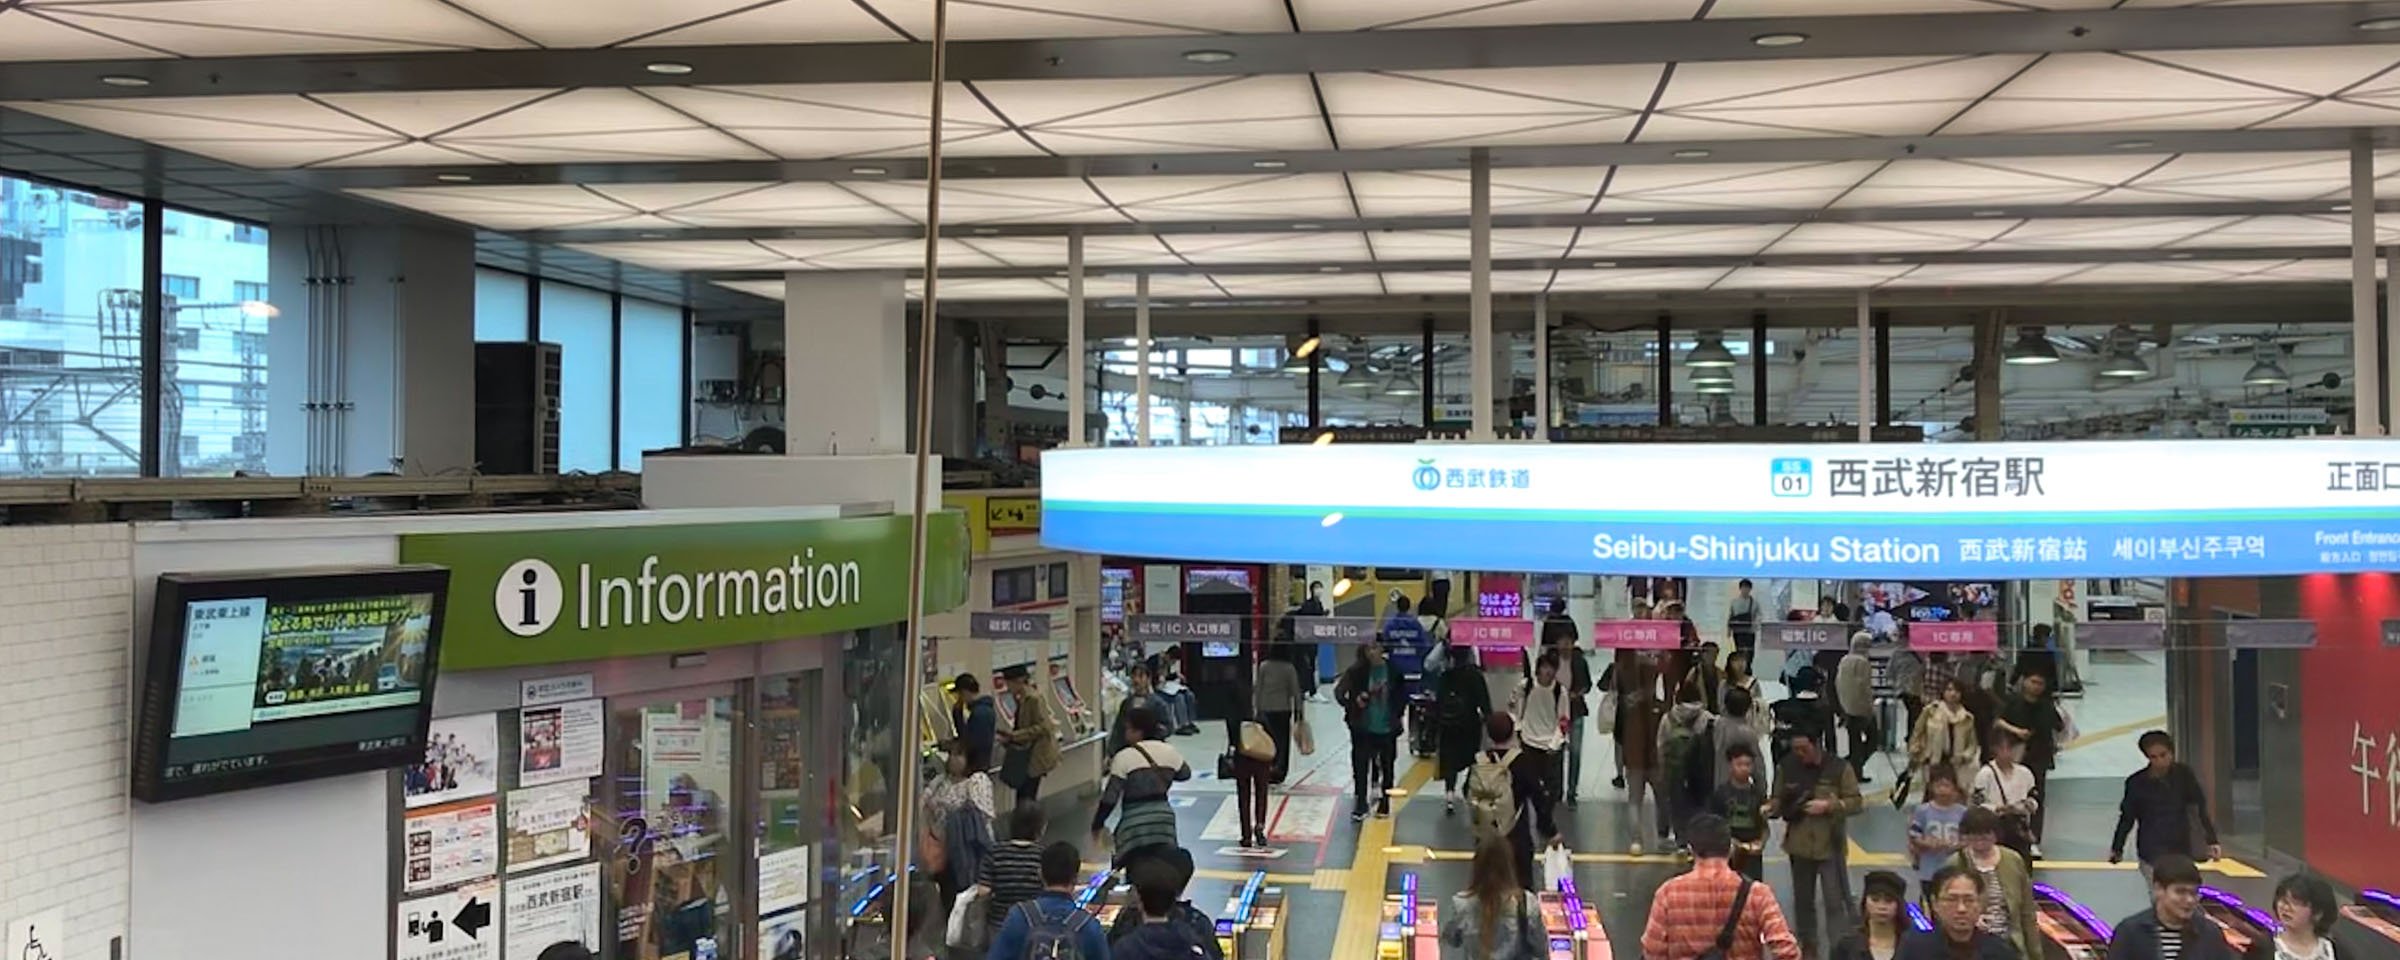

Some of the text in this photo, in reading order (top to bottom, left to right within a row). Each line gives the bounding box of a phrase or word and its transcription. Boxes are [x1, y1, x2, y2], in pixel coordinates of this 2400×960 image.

[1446, 467, 1531, 489] 西武鉄道
[1781, 475, 1803, 492] 01
[1827, 457, 2046, 498] 西武新宿駅
[2326, 460, 2400, 492] 正面口
[1592, 532, 1940, 568] Seibu-Shinjuku Station
[1958, 536, 2087, 563] 西武新宿站
[2112, 534, 2266, 561] 세이부신주쿠역
[2314, 530, 2350, 546] Front
[578, 547, 860, 629] Information
[527, 883, 584, 910] 西武新宿駅
